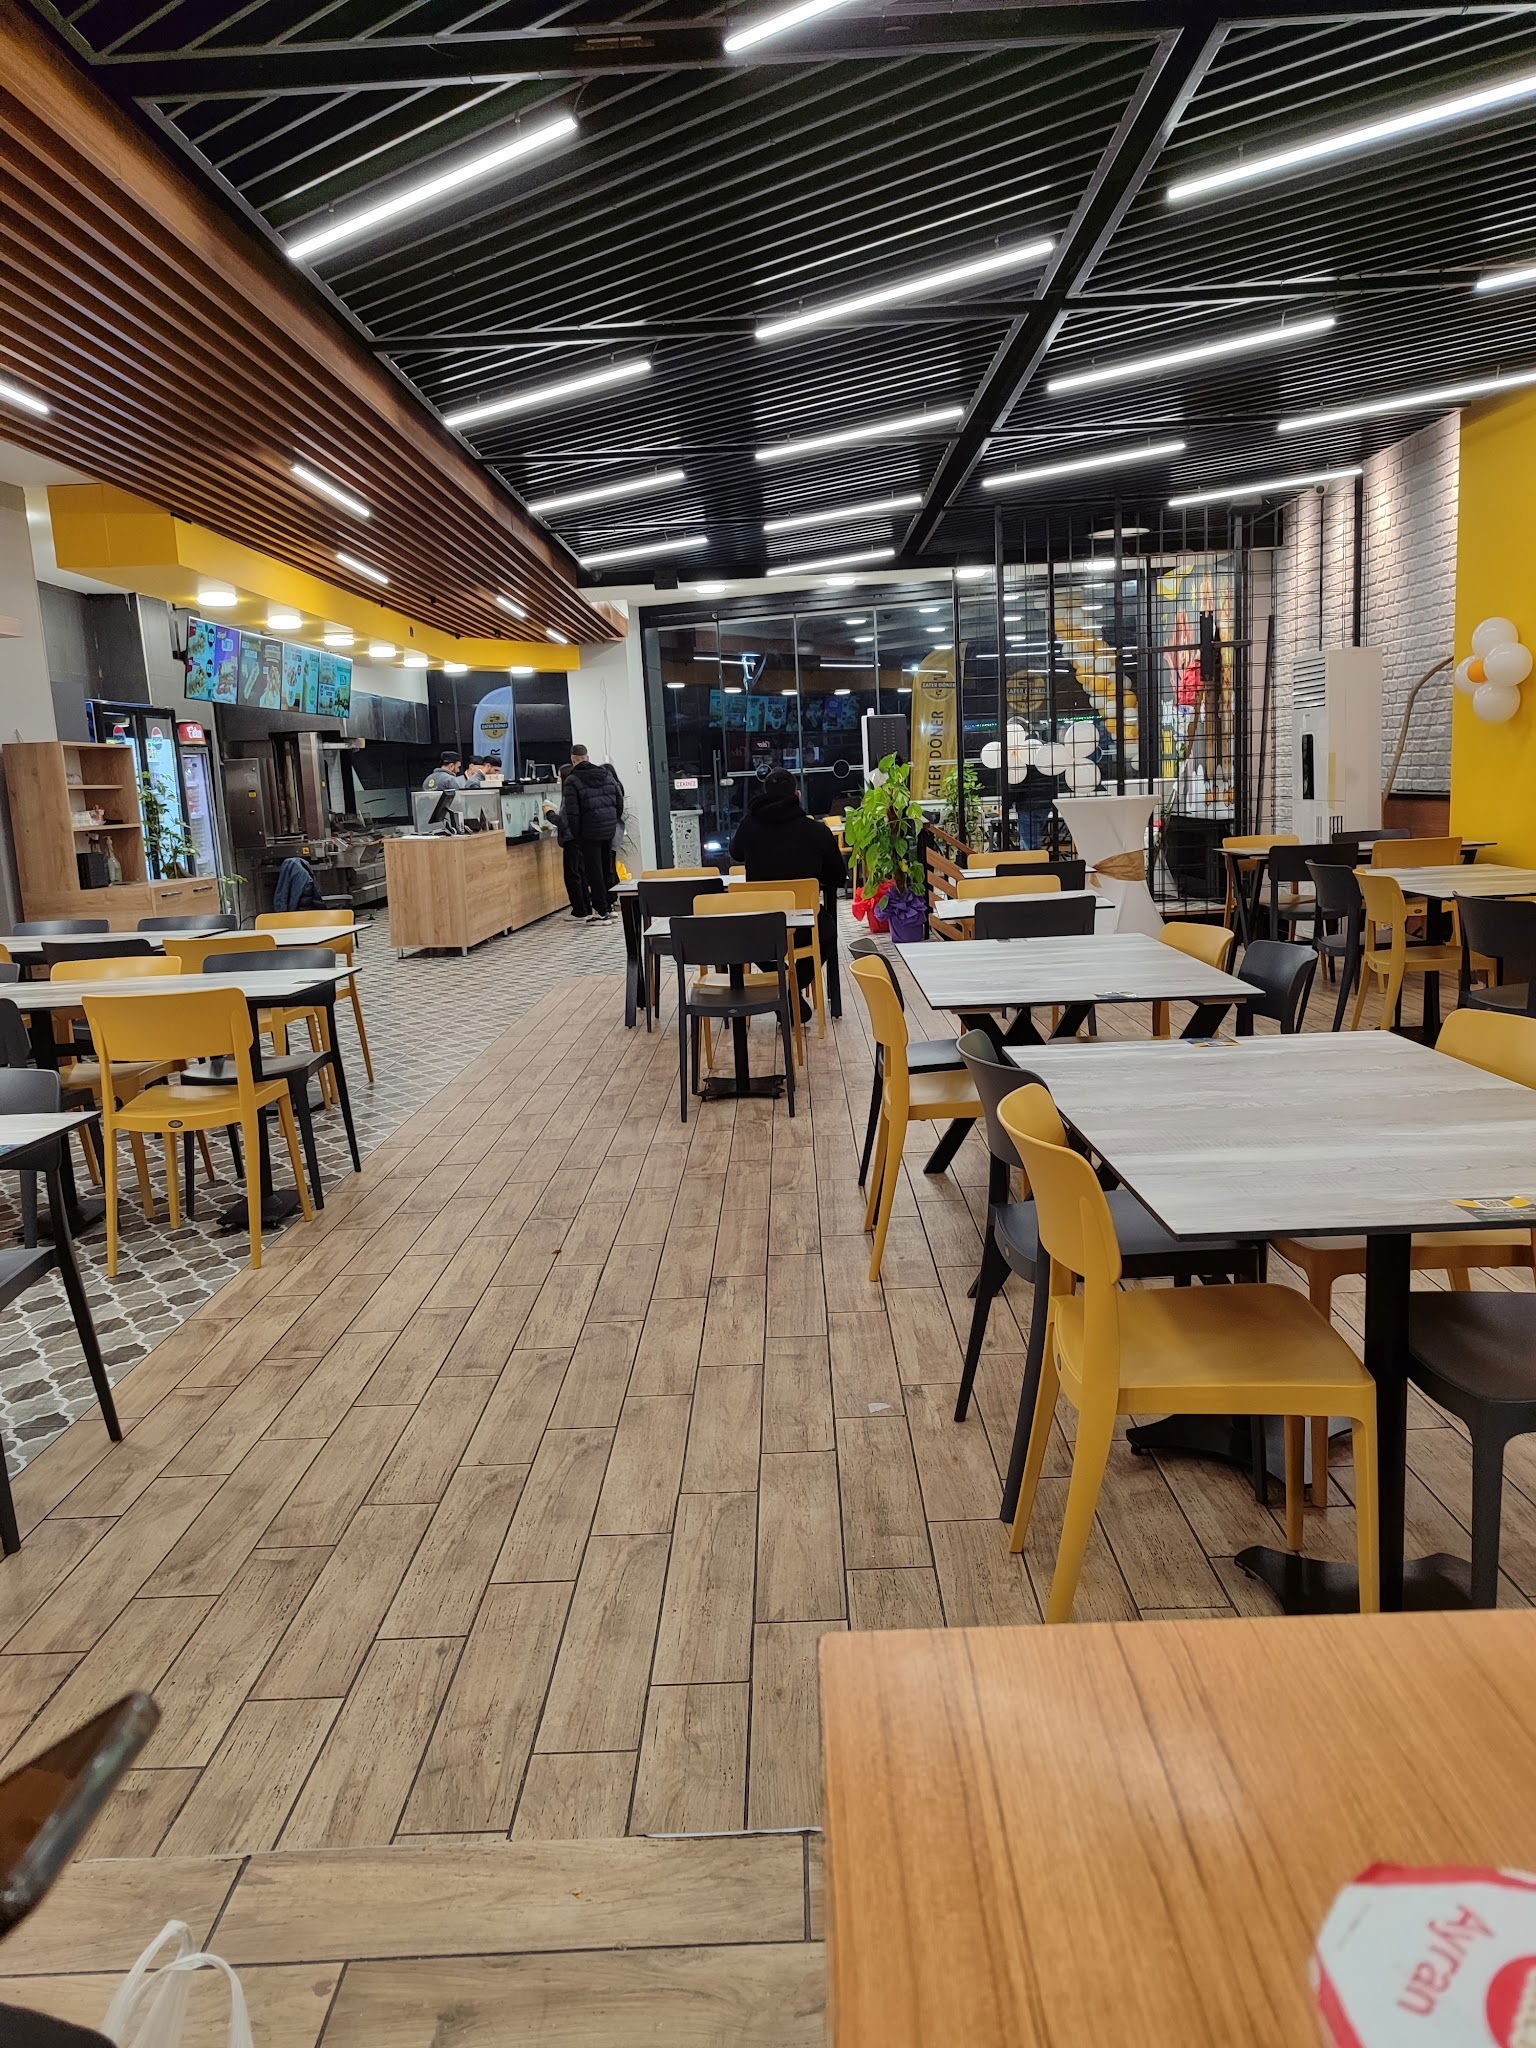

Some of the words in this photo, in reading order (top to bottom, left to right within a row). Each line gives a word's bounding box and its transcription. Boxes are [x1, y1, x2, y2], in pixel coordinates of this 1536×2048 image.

[928, 711, 944, 758] DÖNER
[928, 764, 941, 797] ATER
[1397, 1904, 1494, 2016] Ayran
